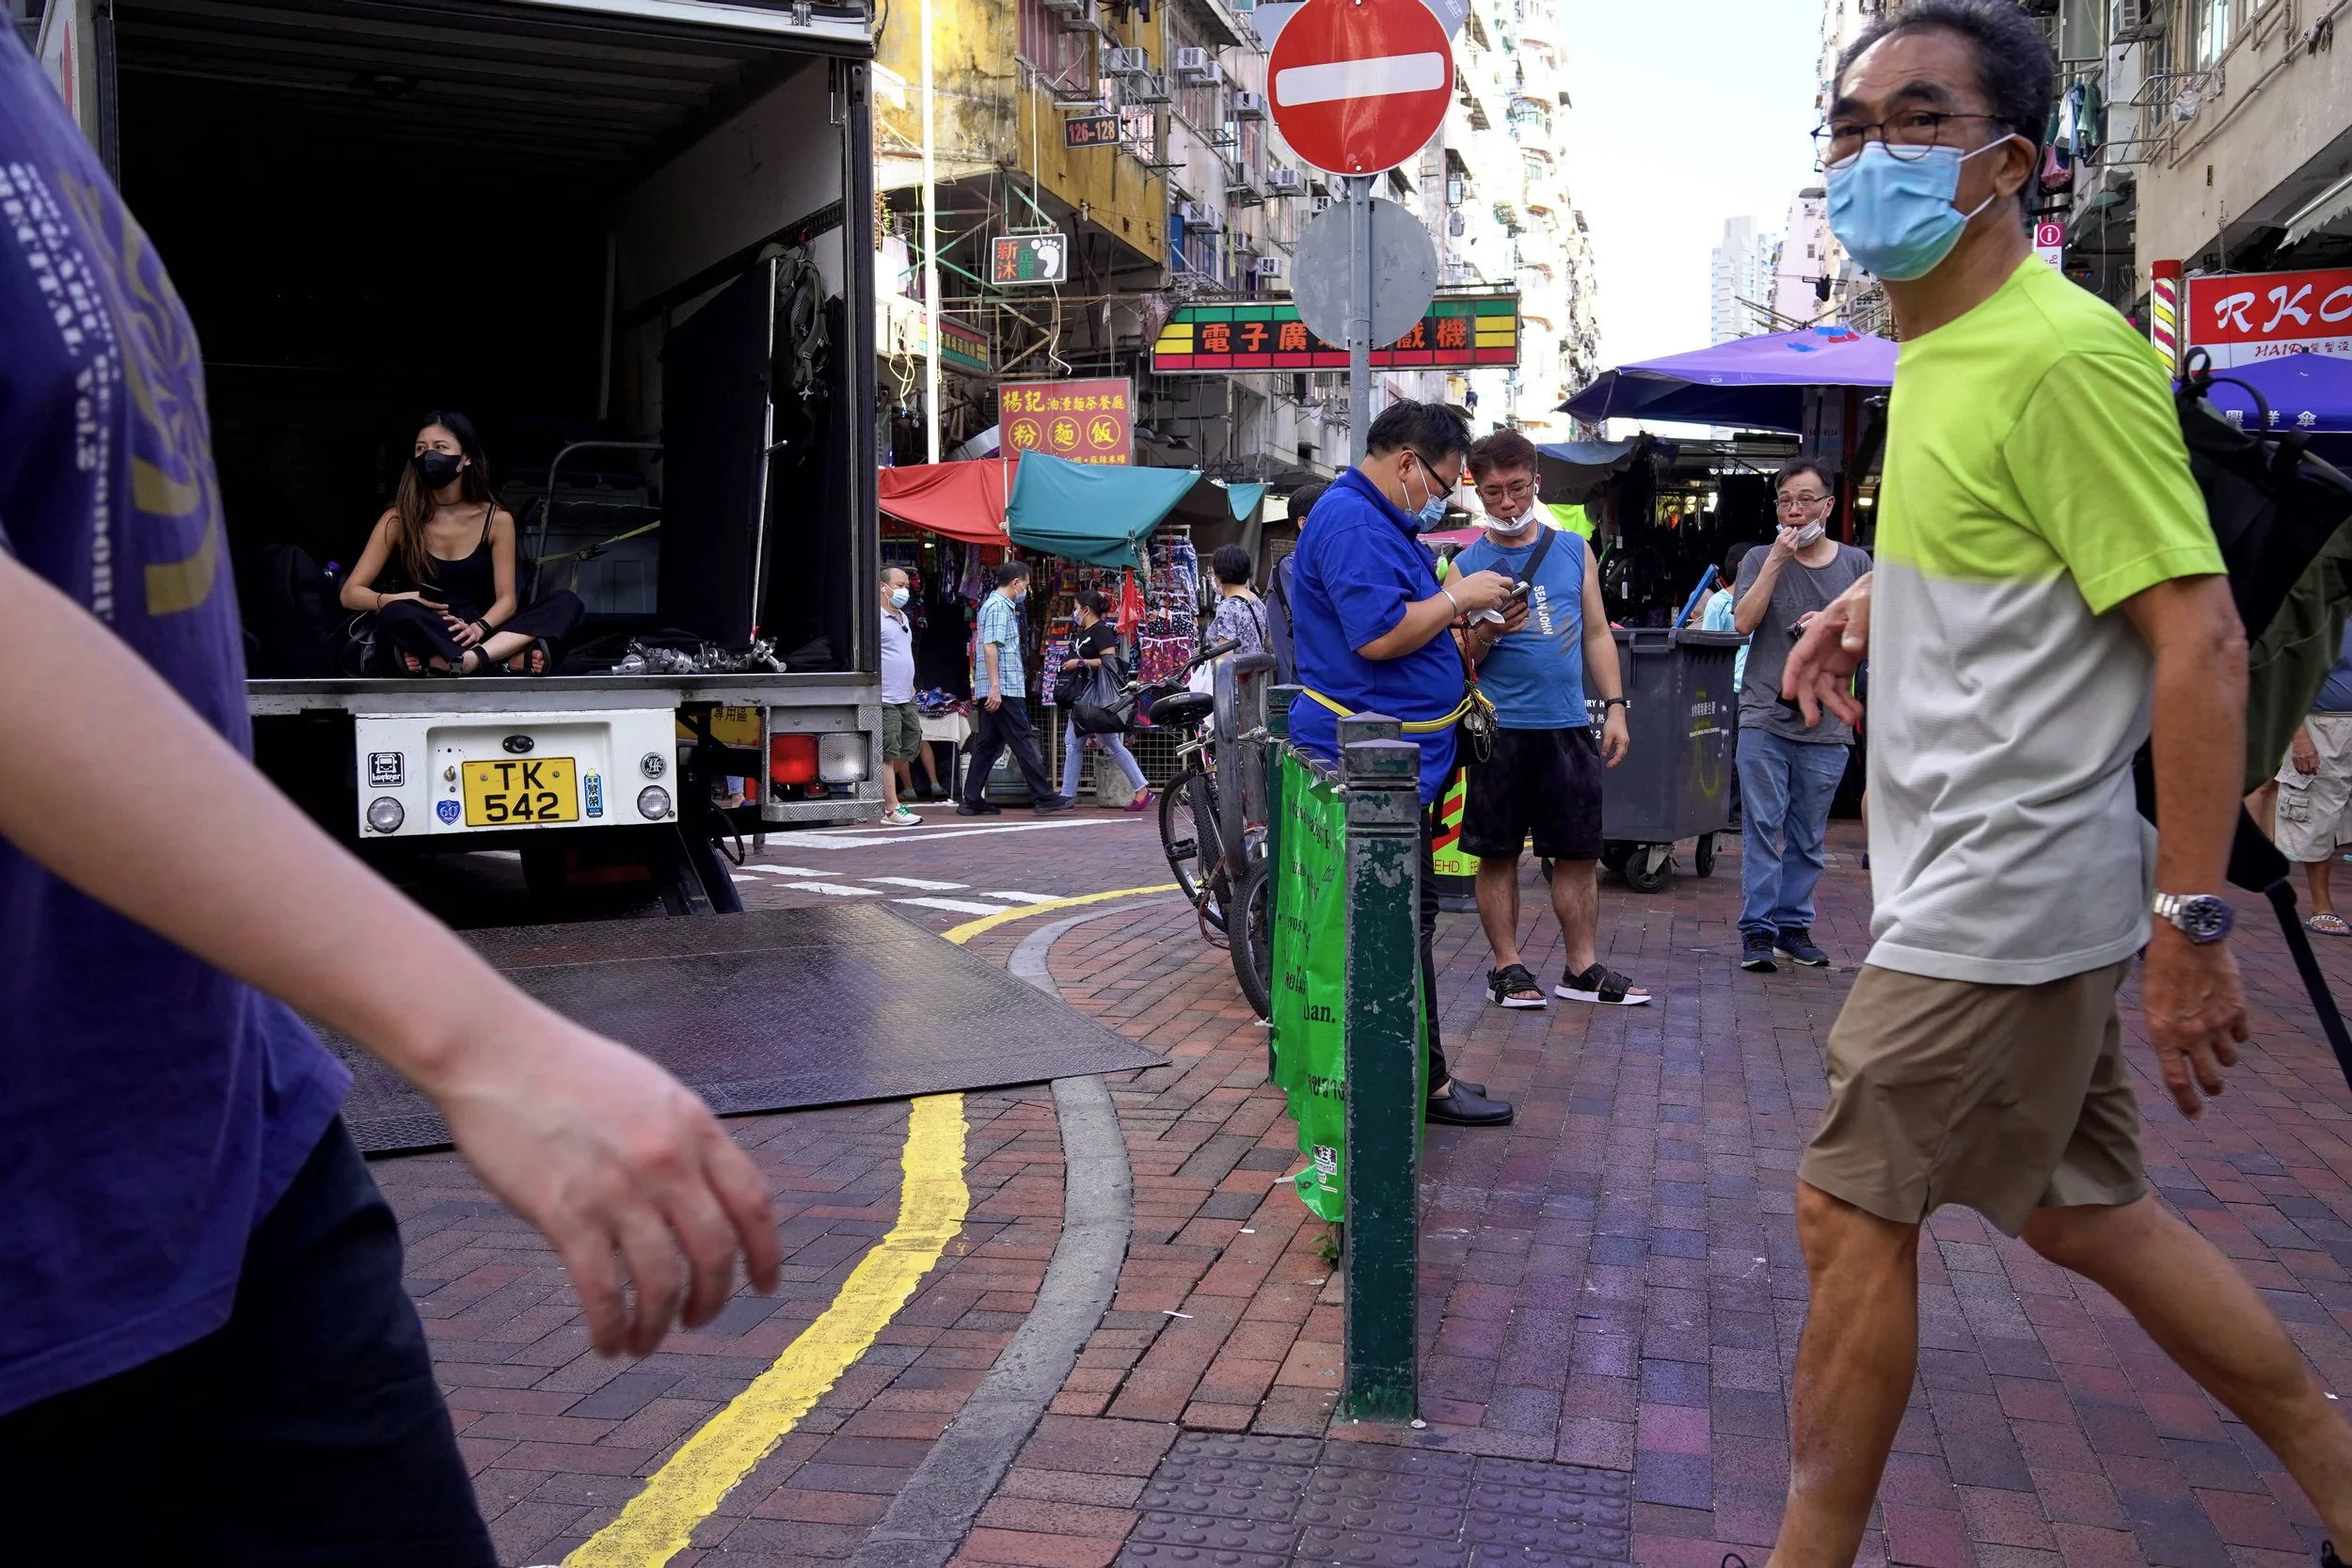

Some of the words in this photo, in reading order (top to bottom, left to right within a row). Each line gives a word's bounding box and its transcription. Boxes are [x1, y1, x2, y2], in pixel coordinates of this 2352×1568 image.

[1069, 119, 1115, 143] 126-128
[997, 240, 1018, 279] 新沐
[1202, 318, 1467, 353] 電子廣戲機
[1003, 390, 1045, 413] 楊記
[1013, 424, 1037, 447] 粉
[1054, 421, 1074, 446] 麵
[1091, 421, 1115, 443] 飯
[1534, 585, 1548, 610] SEAN
[1538, 611, 1554, 635] JOHN
[494, 762, 545, 791] TK
[485, 792, 560, 822] 542
[1434, 859, 1460, 873] EHD
